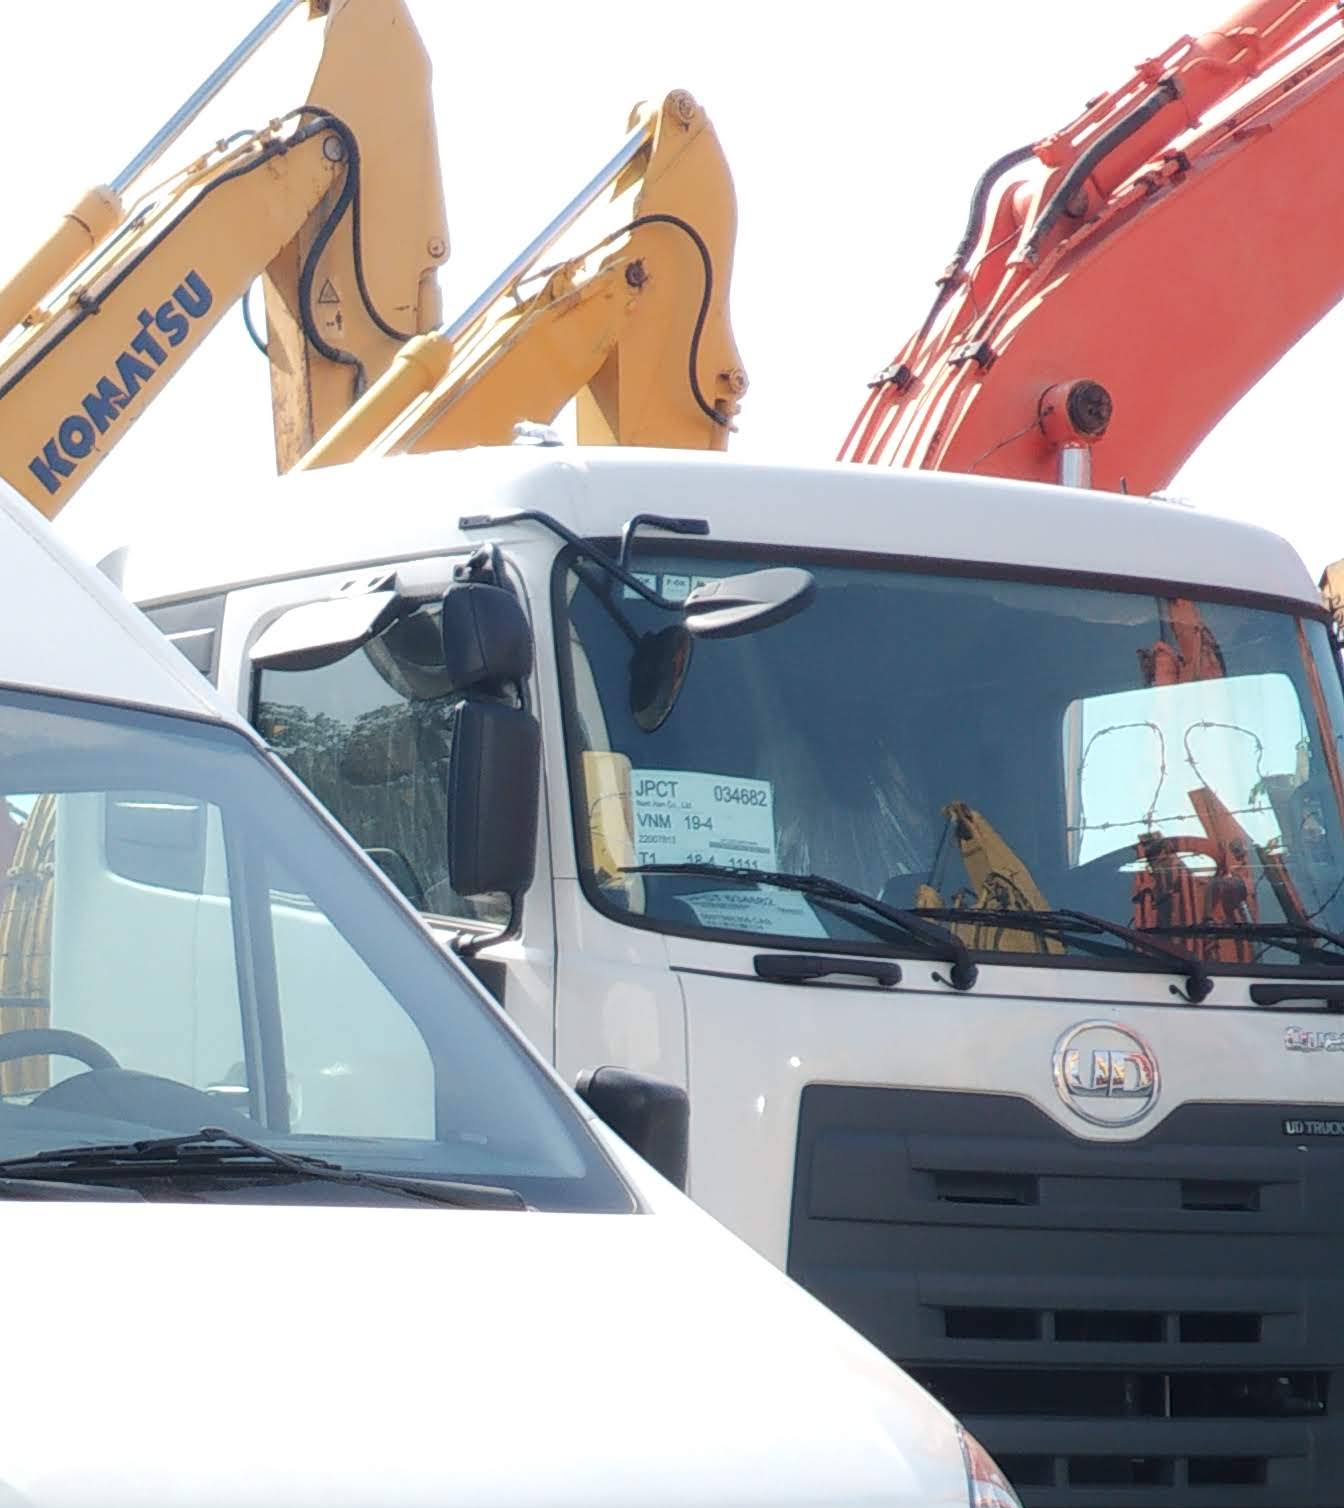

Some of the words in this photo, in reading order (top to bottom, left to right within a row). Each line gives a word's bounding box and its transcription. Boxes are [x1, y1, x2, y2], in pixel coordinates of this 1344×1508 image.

[28, 269, 213, 495] KOMATSU
[636, 780, 678, 798] JPCT
[714, 785, 768, 807] 034682
[637, 813, 672, 829] VNM
[684, 815, 713, 830] 19-4
[638, 851, 656, 865] T1
